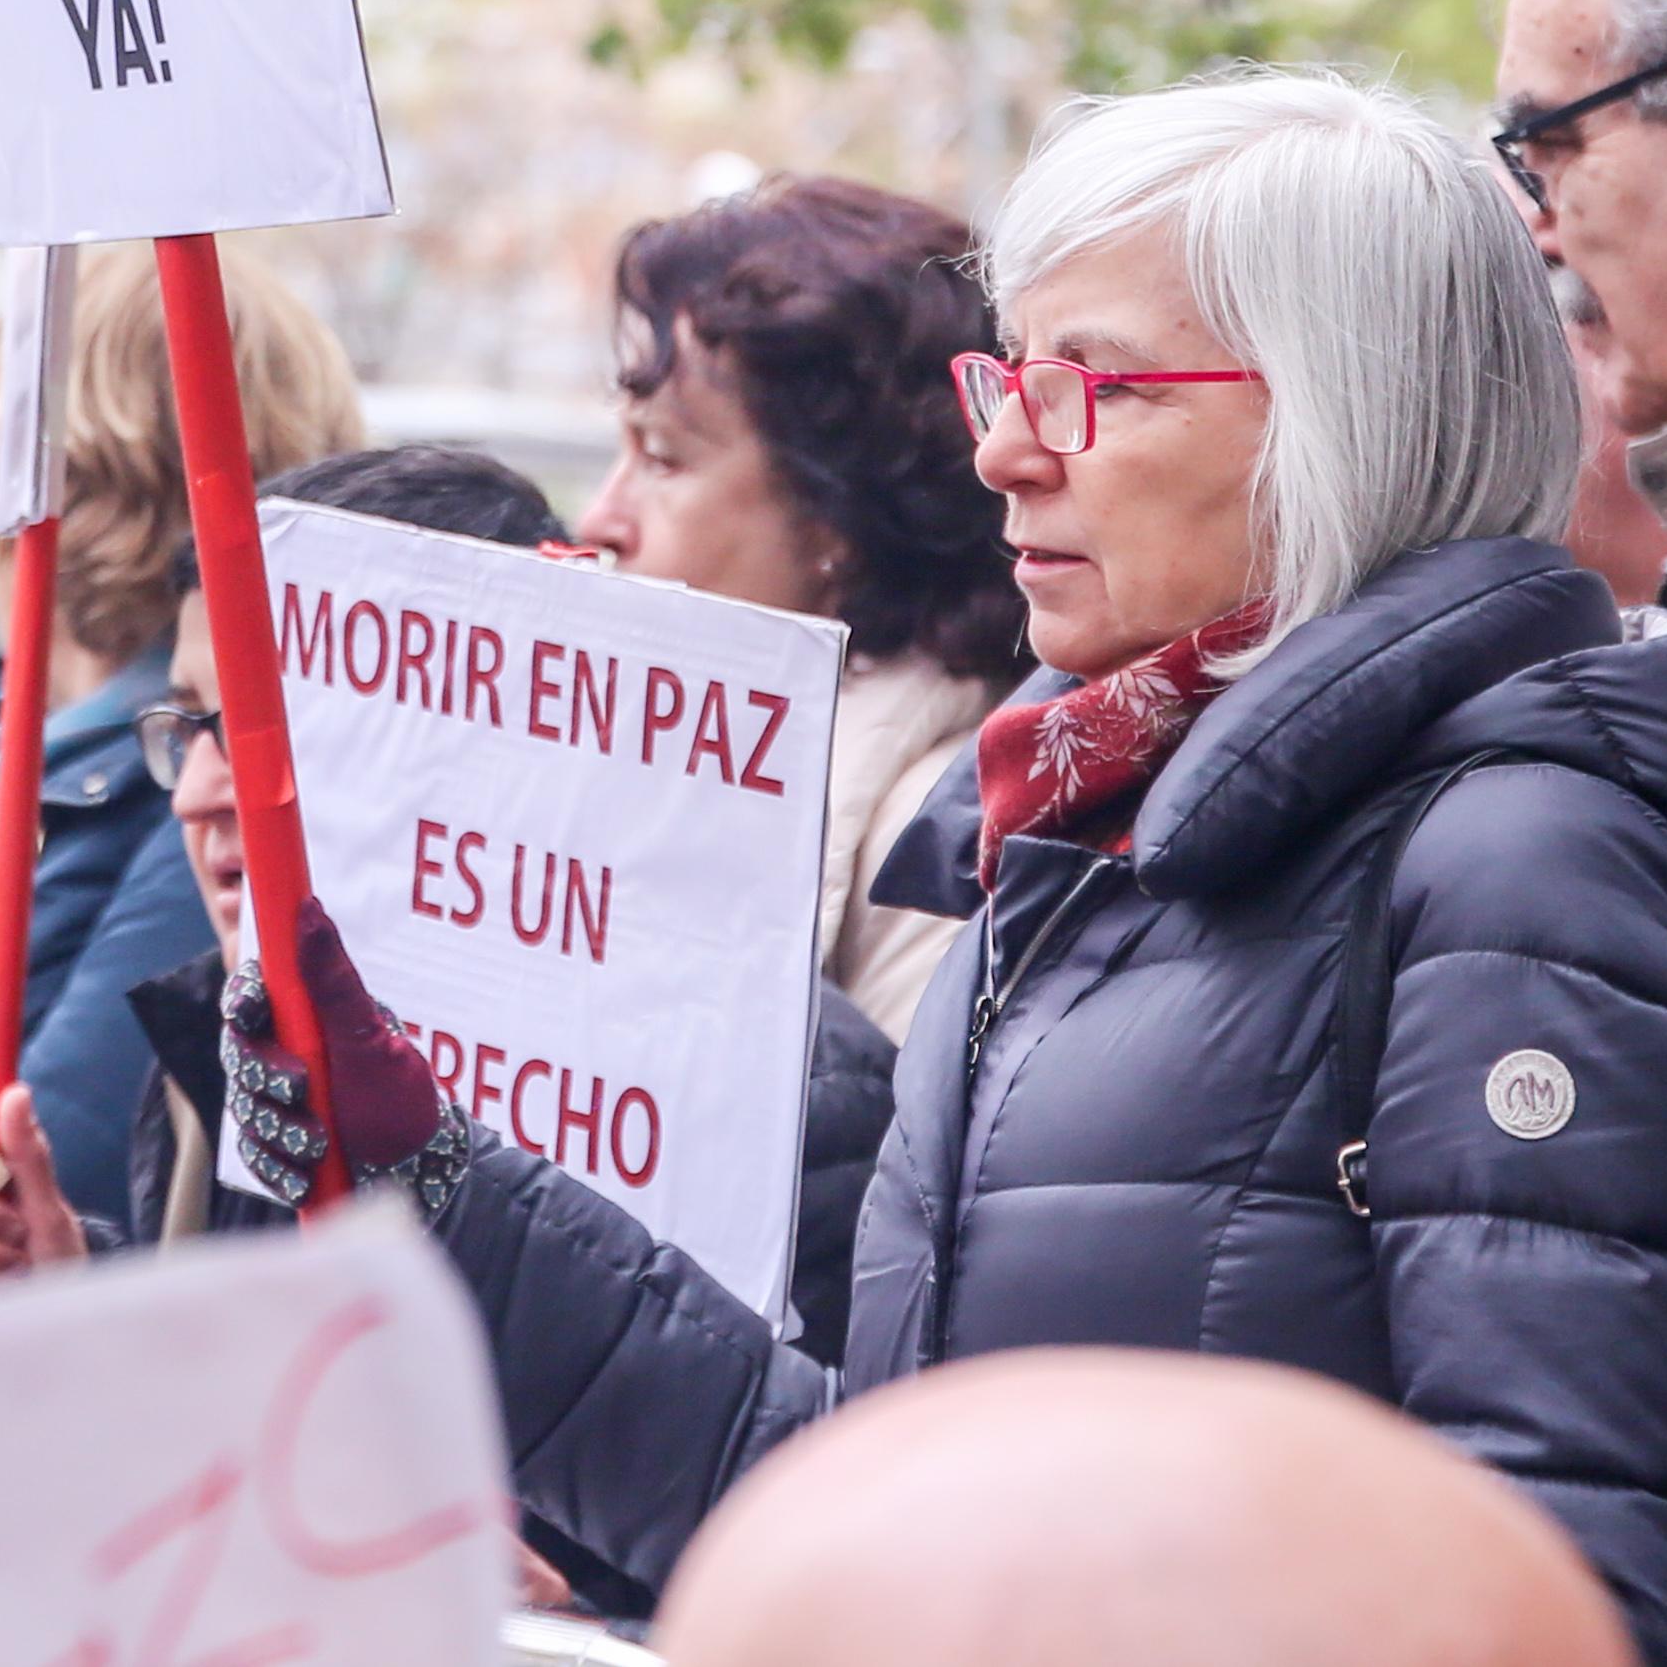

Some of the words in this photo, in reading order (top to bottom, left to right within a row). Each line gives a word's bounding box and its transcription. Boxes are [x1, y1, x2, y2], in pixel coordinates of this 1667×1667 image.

[280, 582, 505, 729] MORIR
[527, 639, 619, 756] EN
[641, 666, 792, 798] PAZ
[411, 818, 488, 930] ES
[510, 843, 613, 964] UN
[400, 1021, 663, 1190] RECHO
